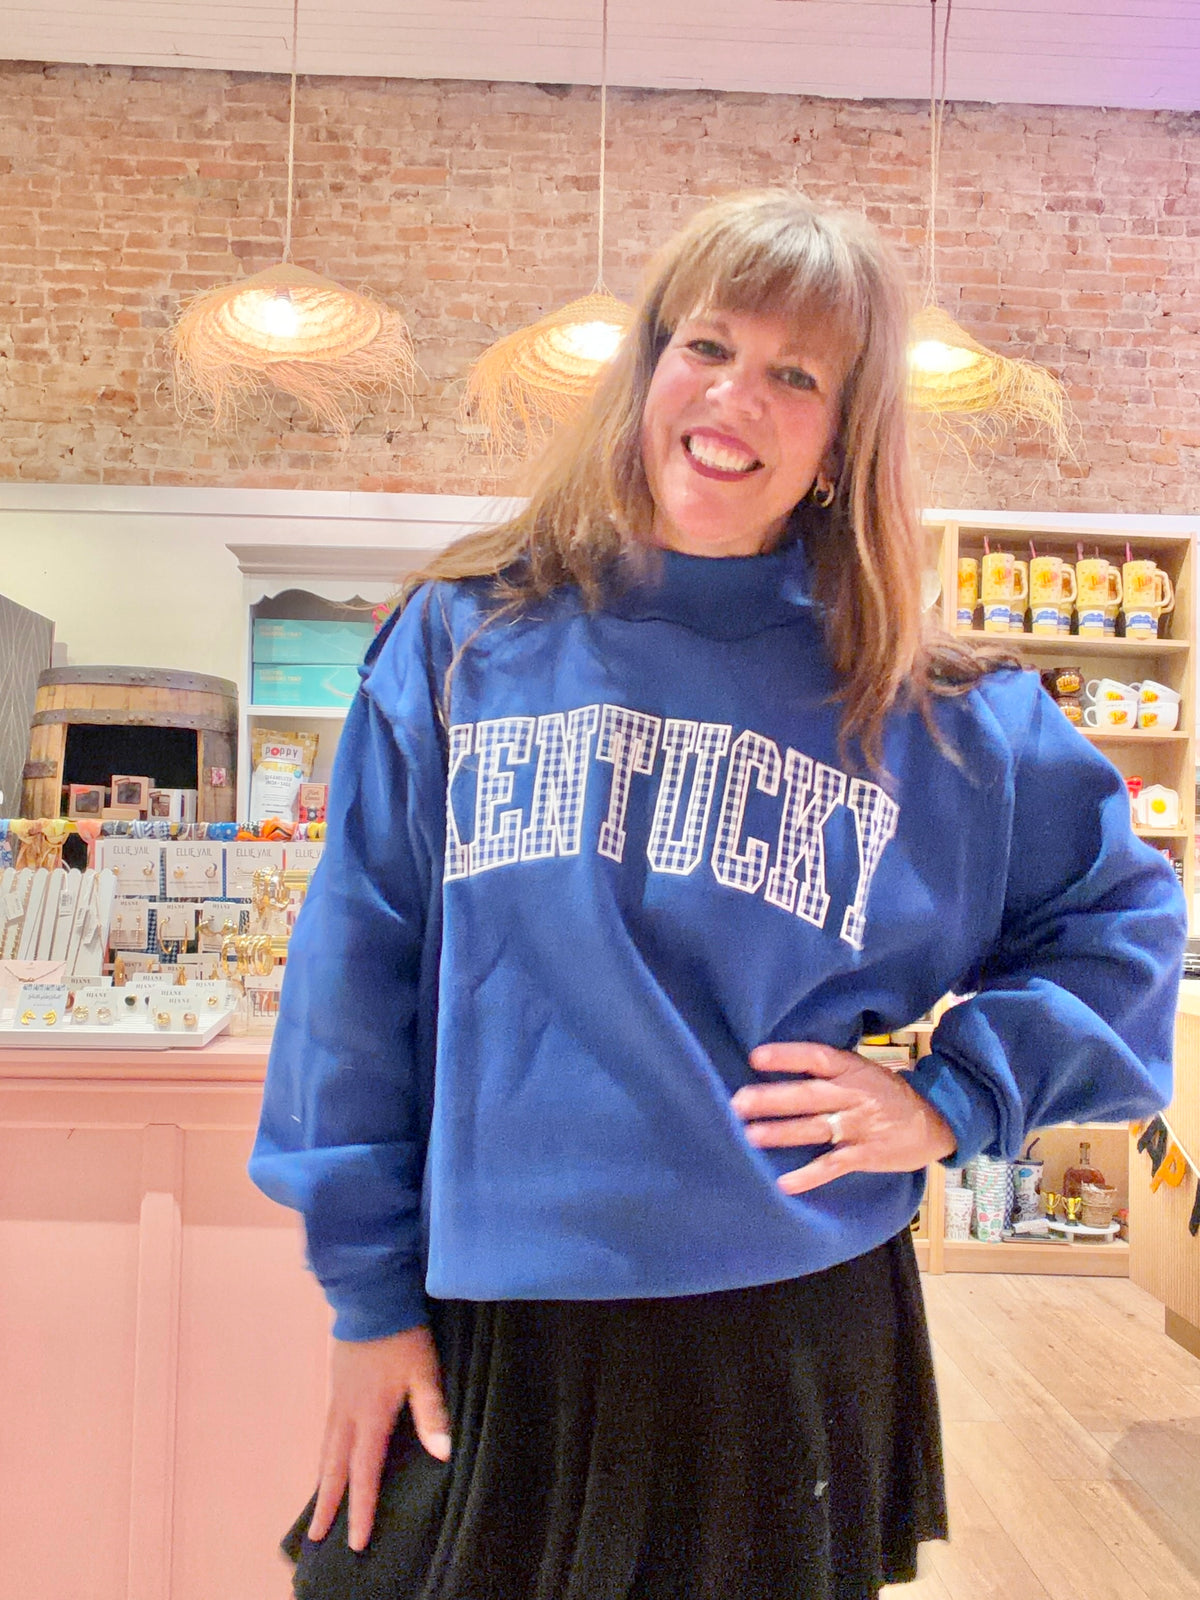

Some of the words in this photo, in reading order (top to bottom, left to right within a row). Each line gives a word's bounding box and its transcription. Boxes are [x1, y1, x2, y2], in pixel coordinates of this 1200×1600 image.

[265, 746, 298, 759] POPPY
[113, 845, 131, 855] ELLIE
[176, 847, 194, 857] ELLIE
[236, 848, 254, 858] ELLIE
[295, 848, 313, 858] ELLIE
